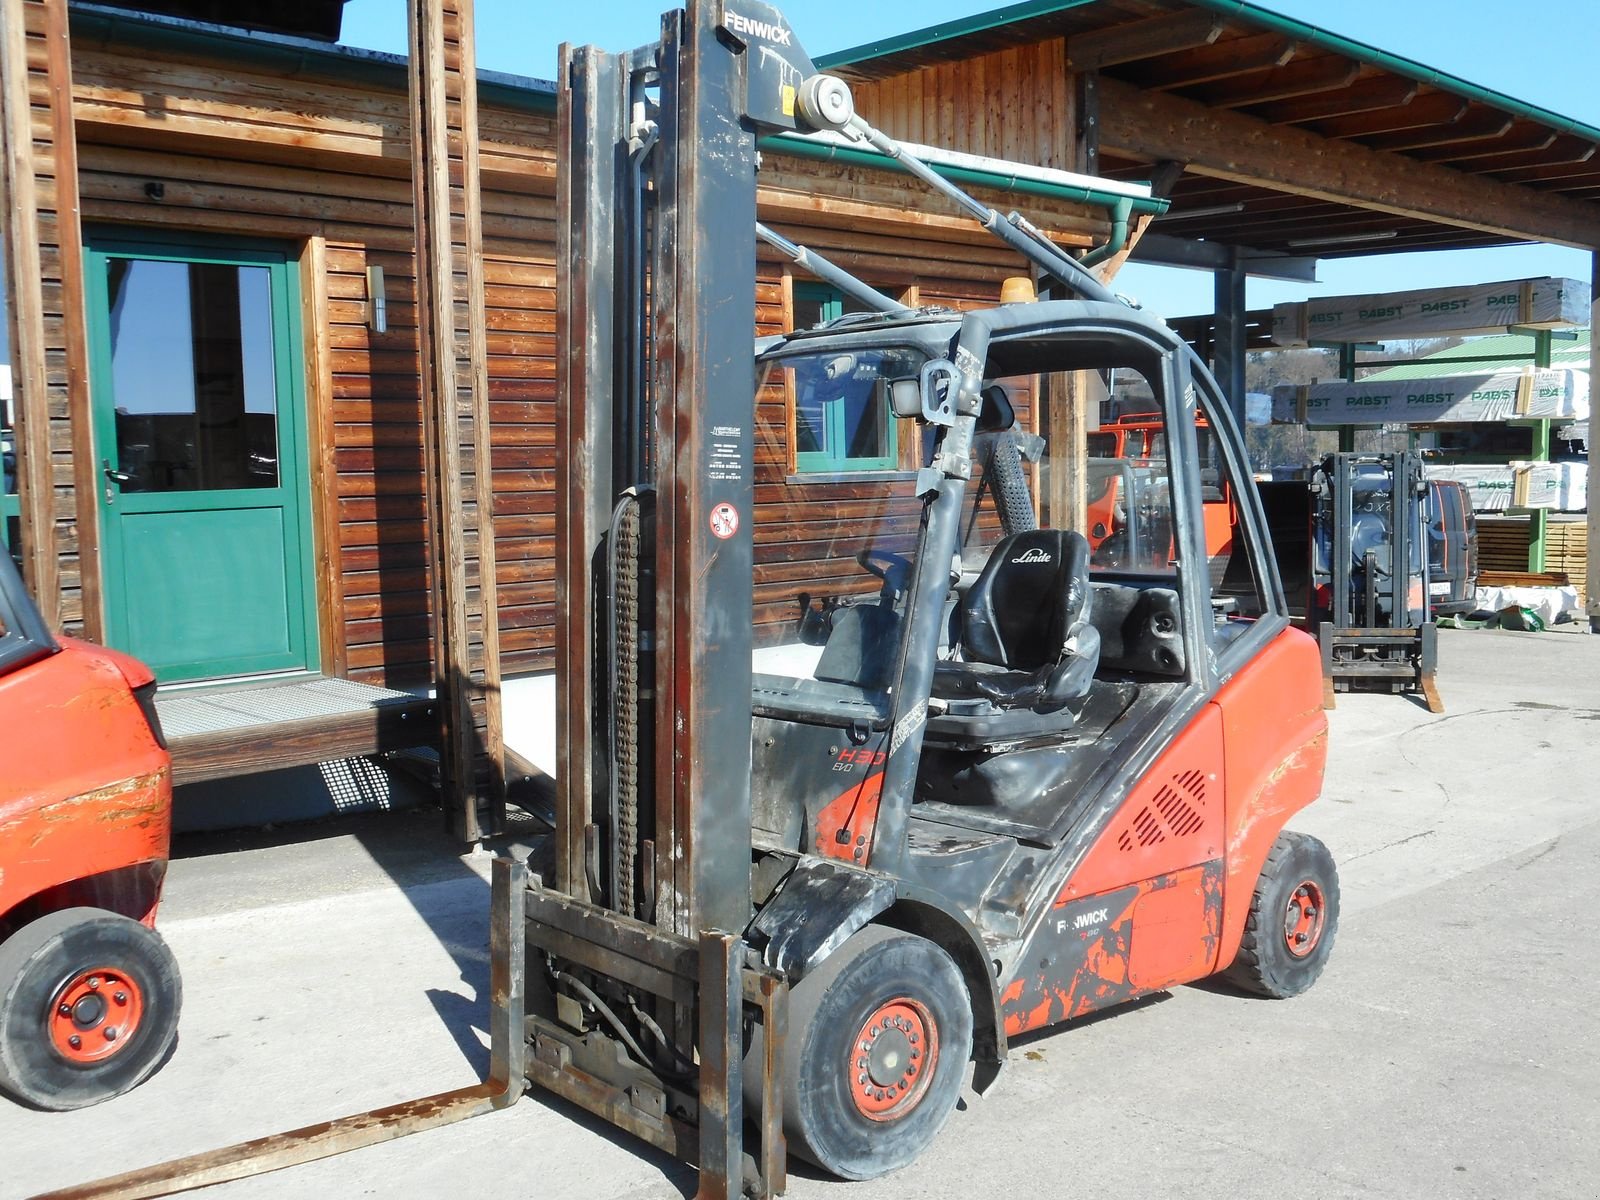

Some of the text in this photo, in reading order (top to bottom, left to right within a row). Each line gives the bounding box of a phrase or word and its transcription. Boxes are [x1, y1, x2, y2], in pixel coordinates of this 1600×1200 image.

[724, 11, 791, 46] FENWICK
[1359, 305, 1403, 319] PABST
[1420, 299, 1470, 313] PABST
[1289, 397, 1331, 407] PBST
[1346, 395, 1392, 406] PABST
[1407, 393, 1455, 404] PABST
[1012, 548, 1051, 563] Linde
[832, 762, 853, 772] EVO
[1057, 908, 1108, 934] FNWICK
